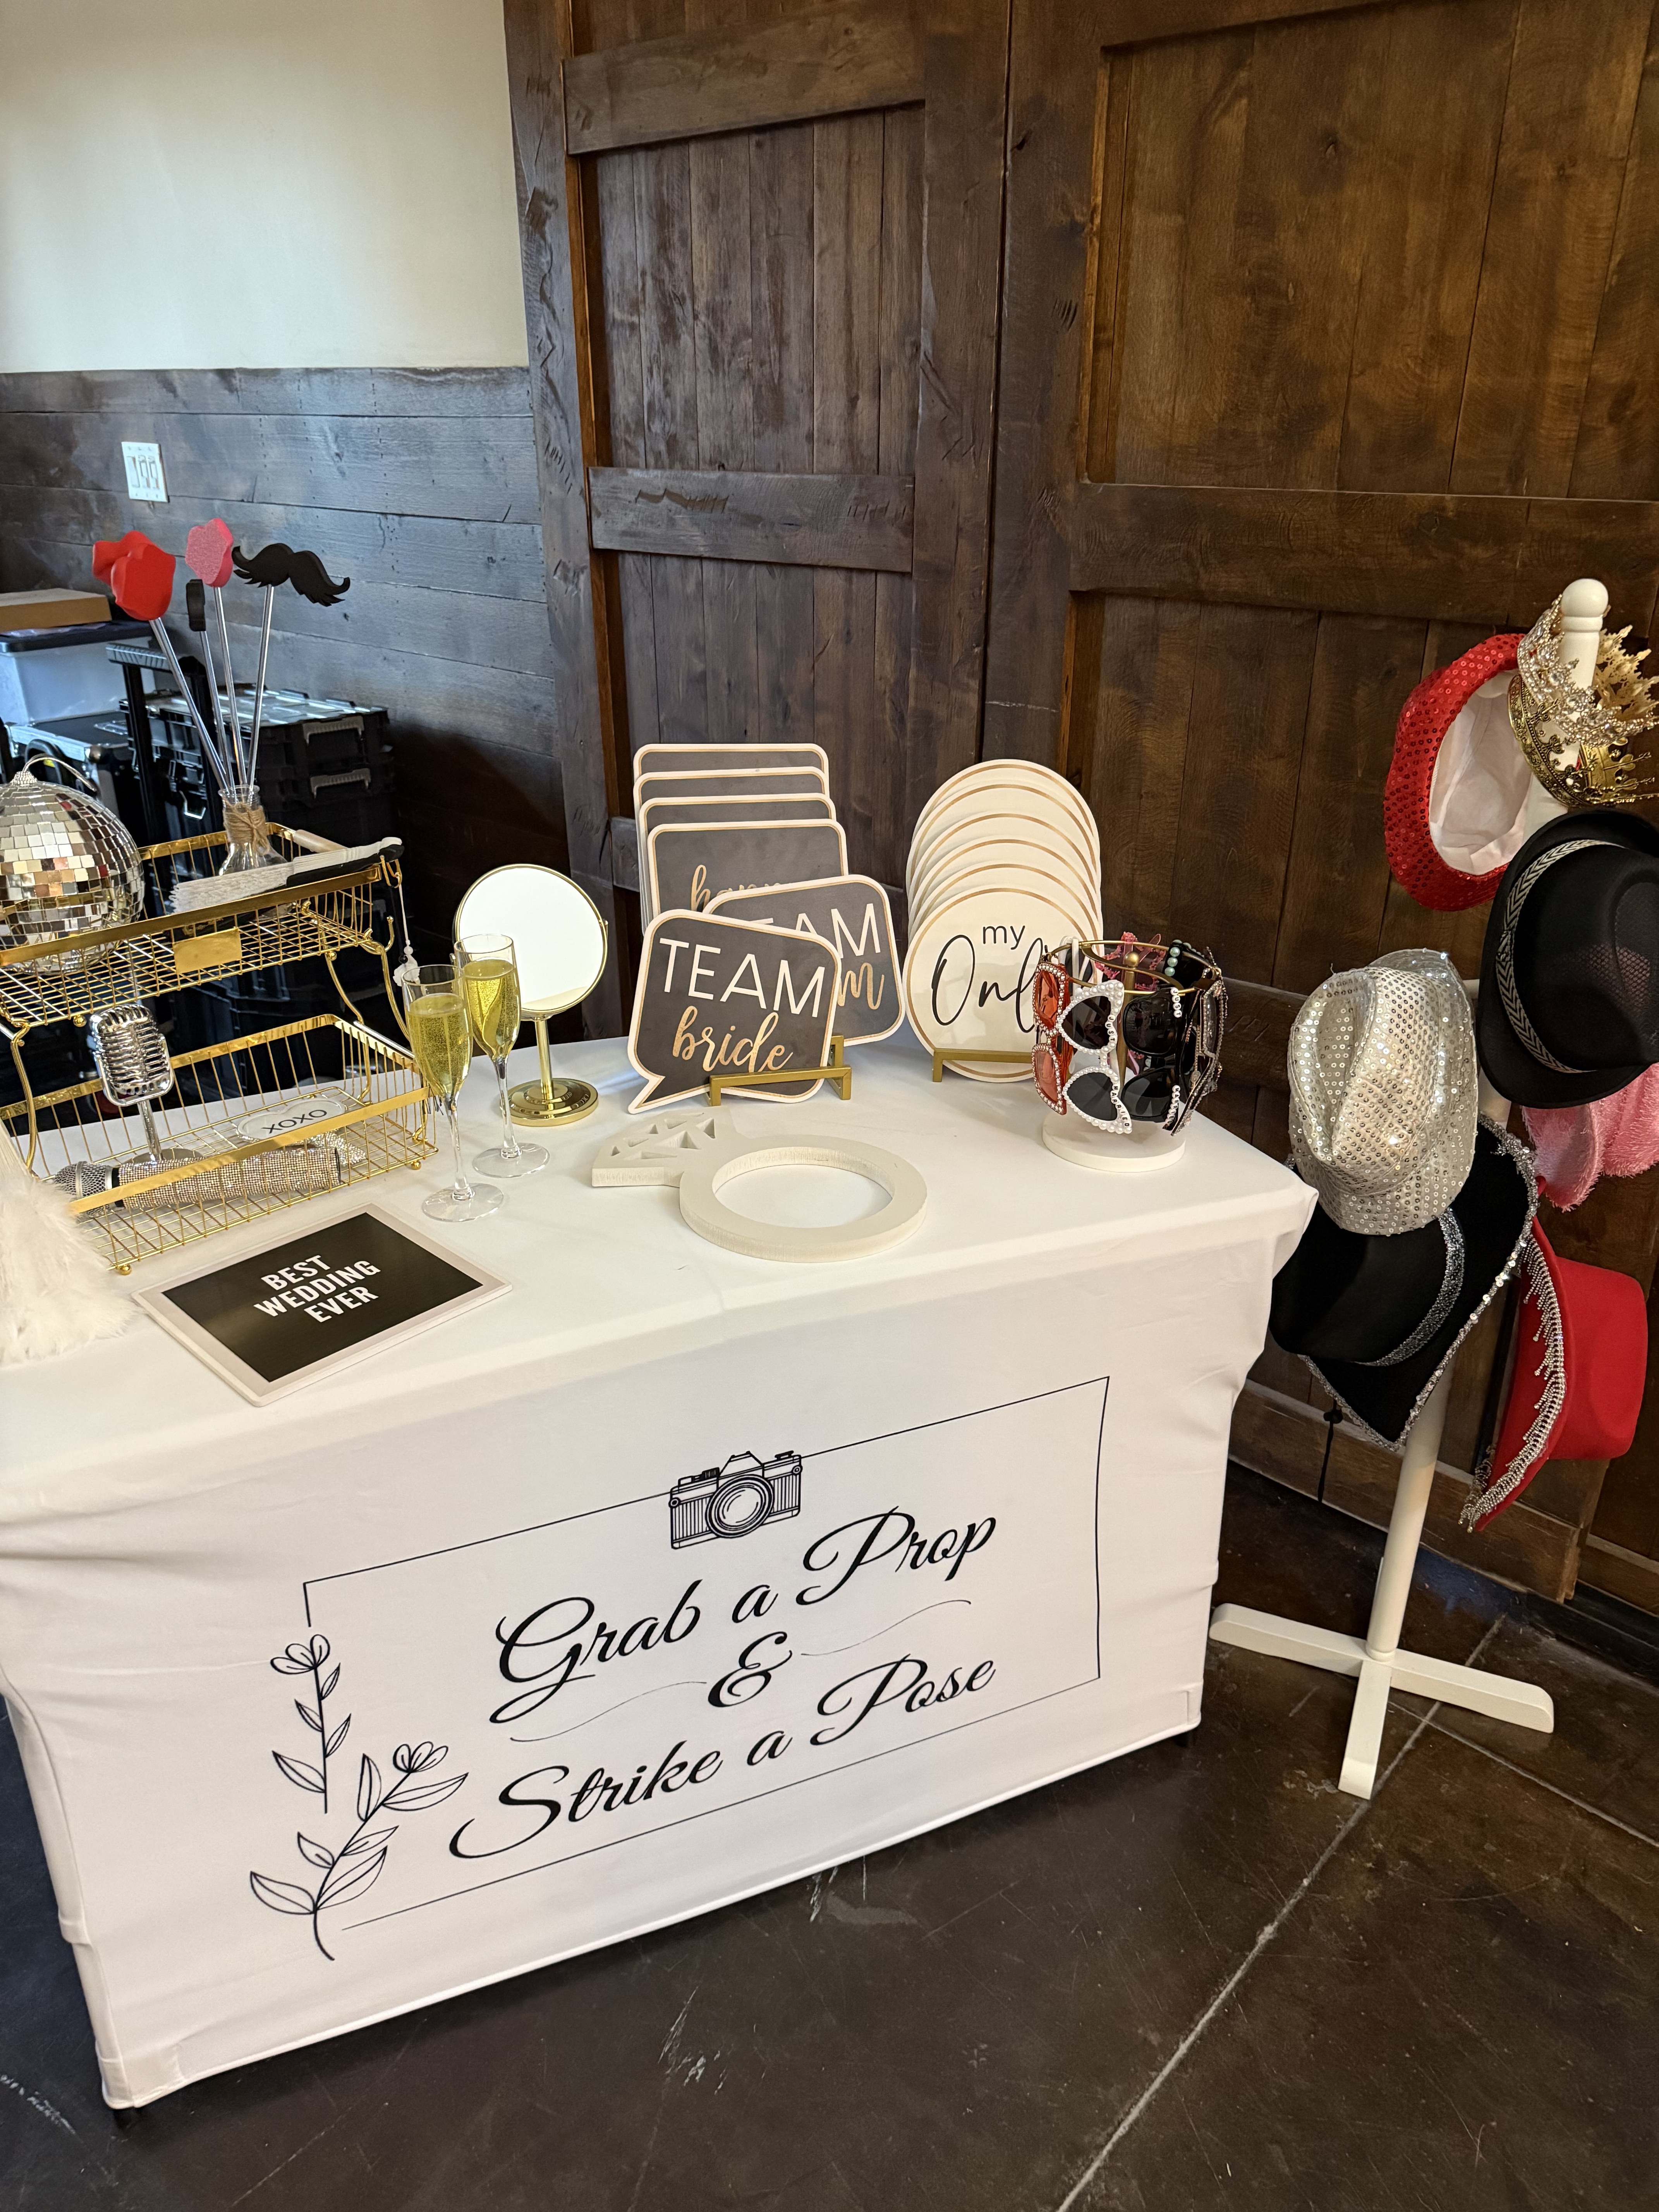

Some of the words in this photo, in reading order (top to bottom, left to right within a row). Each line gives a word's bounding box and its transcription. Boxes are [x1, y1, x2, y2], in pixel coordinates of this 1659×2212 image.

[982, 925, 1025, 950] my
[659, 938, 826, 1018] TEAM
[931, 934, 1048, 1033] Onl
[1173, 990, 1181, 1016] JUST
[673, 1006, 793, 1073] bride
[1106, 1016, 1115, 1042] JUST
[1111, 1085, 1130, 1127] MARRIED
[261, 1109, 327, 1134] XOXO
[253, 1261, 381, 1317] WEDDING
[261, 1255, 331, 1290] BEST
[304, 1286, 379, 1322] EVER
[489, 1579, 702, 1724] Grab
[731, 1584, 779, 1623] a
[795, 1505, 997, 1606] Prop
[708, 1631, 793, 1708] &
[449, 1740, 723, 1859] Strike
[747, 1730, 793, 1766] a
[810, 1654, 996, 1746] Pose
